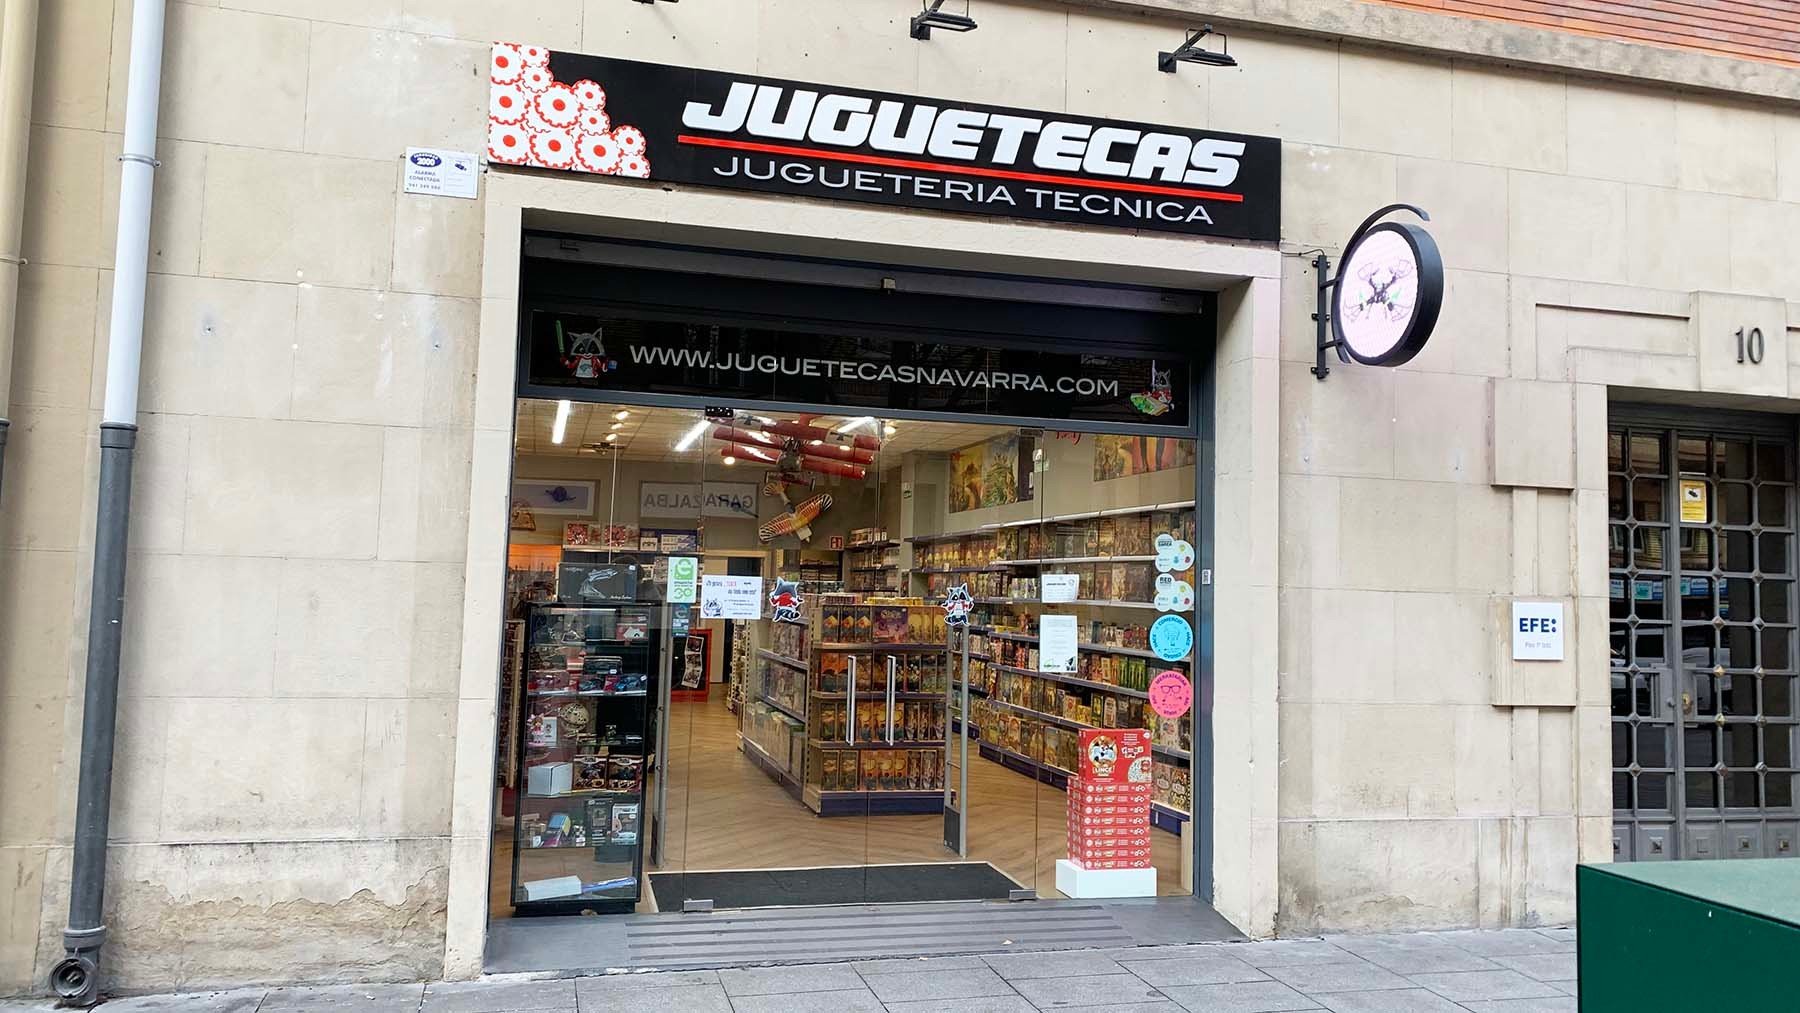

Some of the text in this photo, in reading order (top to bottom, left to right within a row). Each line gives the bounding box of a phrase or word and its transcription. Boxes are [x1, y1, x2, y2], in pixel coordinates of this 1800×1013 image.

[681, 82, 1246, 188] JUGUETECAS
[713, 156, 1215, 225] JUGUETERIA TECNICA
[629, 344, 1119, 397] WWW.JUGUETECASNAVARRA.COM
[1734, 326, 1765, 364] 10
